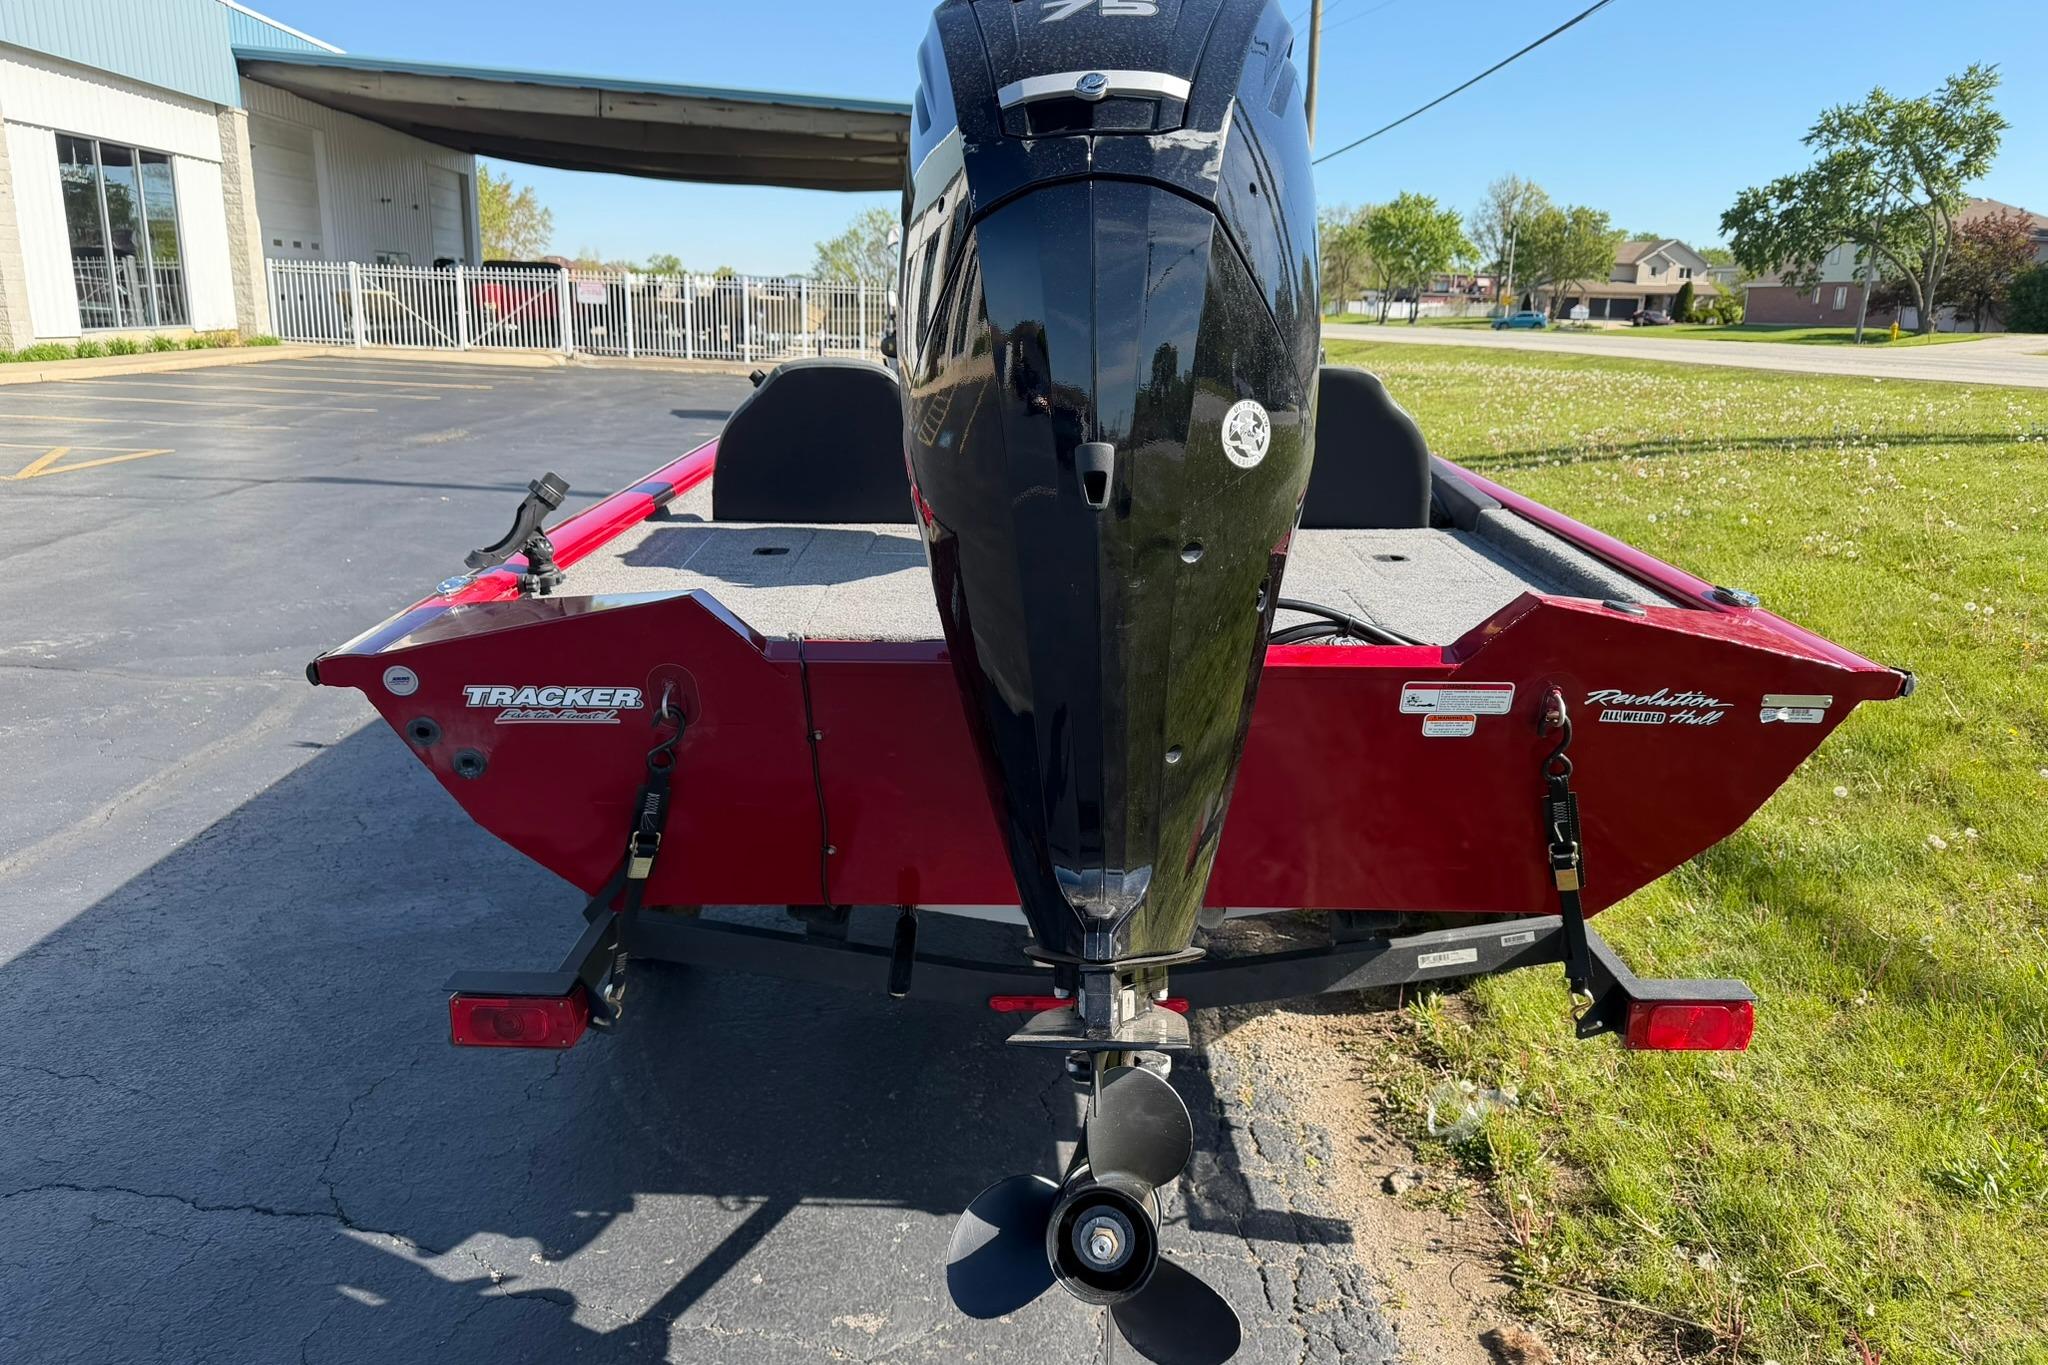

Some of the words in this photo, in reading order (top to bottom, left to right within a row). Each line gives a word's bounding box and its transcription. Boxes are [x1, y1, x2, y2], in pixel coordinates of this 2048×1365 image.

[1039, 0, 1158, 23] 75
[465, 687, 641, 706] TRACKER
[1584, 687, 1735, 707] Revolution
[1602, 711, 1620, 721] ALL
[1623, 712, 1664, 723] WELDED
[1669, 709, 1724, 725] Hull
